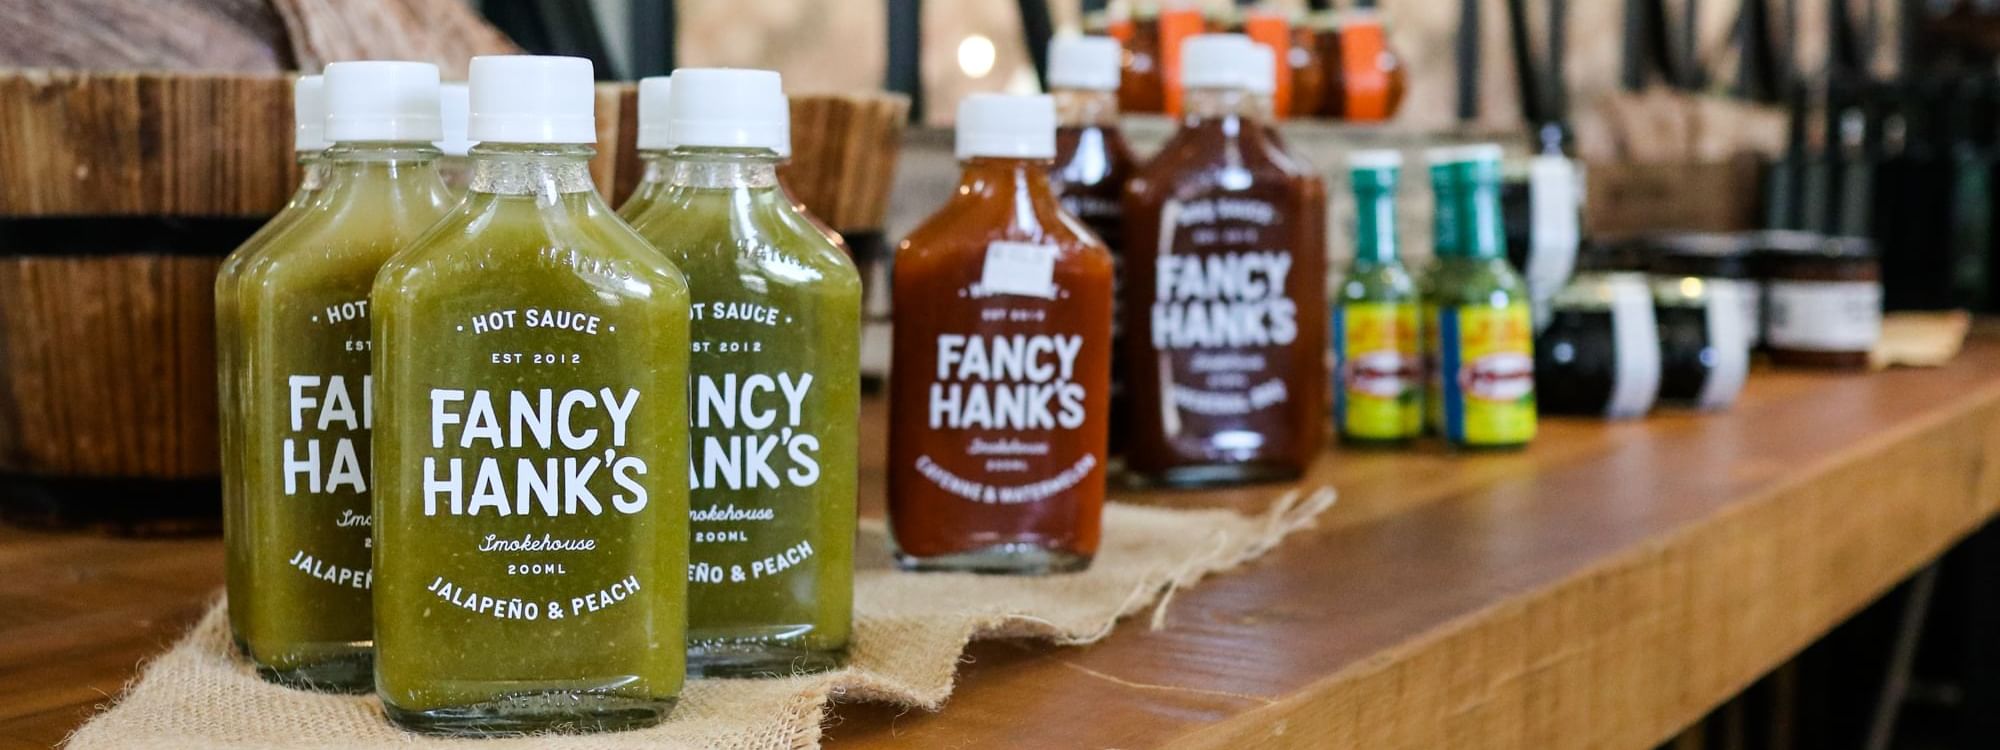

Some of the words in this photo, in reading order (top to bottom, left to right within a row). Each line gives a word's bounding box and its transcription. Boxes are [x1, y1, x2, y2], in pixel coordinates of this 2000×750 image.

[1155, 250, 1293, 303] FANCY
[326, 300, 368, 324] HOT
[472, 309, 517, 335] HOT
[525, 308, 601, 336] SAUCE
[713, 302, 779, 326] SAUCE
[491, 353, 523, 364] EST
[533, 353, 581, 364] 2012
[690, 341, 711, 353] ST
[719, 341, 763, 353] 2012
[936, 333, 1083, 384] FANCY
[429, 386, 641, 450] FANCY
[689, 371, 814, 431] NCY
[928, 376, 1086, 430] HANK'S
[422, 448, 649, 517] HANK'S
[478, 533, 597, 552] Smokehouse
[695, 530, 748, 543] 200ML
[507, 564, 567, 576] 200ML
[730, 564, 746, 583] &
[752, 540, 814, 580] PEACH
[428, 576, 539, 621] JALAPEÑO
[547, 601, 564, 620] &
[571, 575, 642, 617] PEACH
